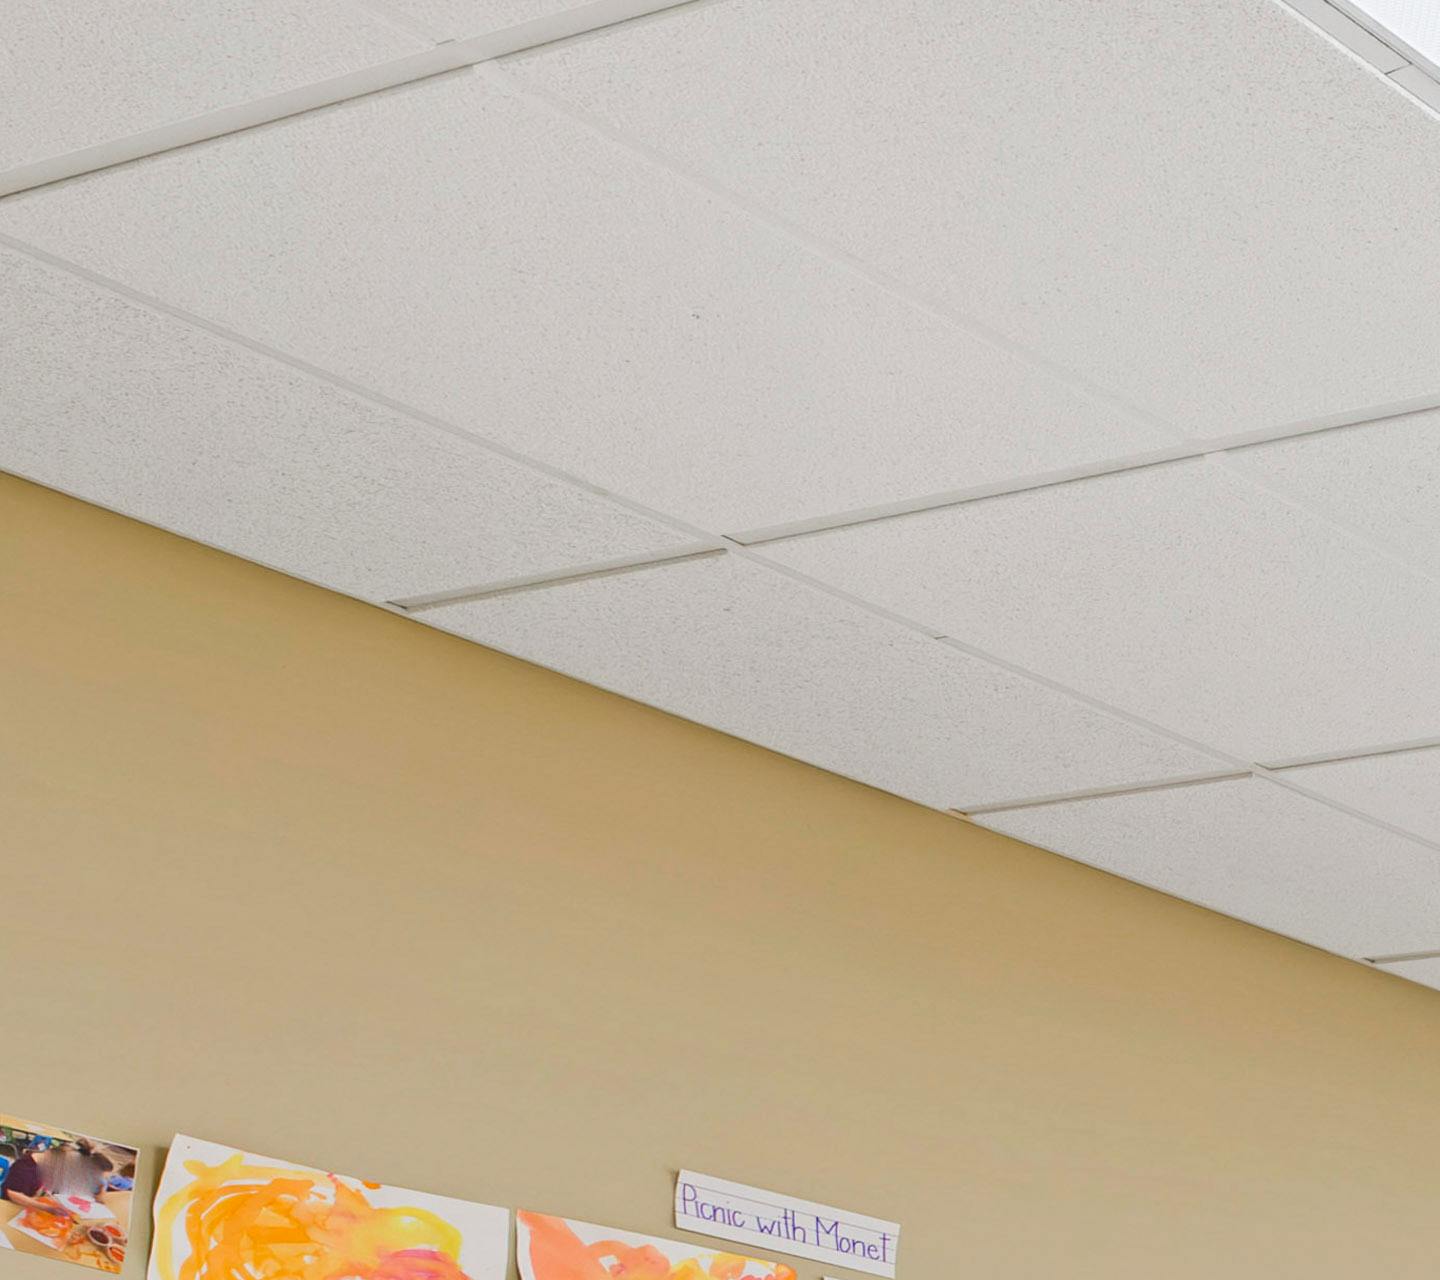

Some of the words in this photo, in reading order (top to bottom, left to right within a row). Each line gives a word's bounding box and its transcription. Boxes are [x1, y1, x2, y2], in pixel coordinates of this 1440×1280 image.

[681, 1182, 746, 1229] Picnic
[756, 1207, 807, 1244] with
[815, 1215, 891, 1263] Monet
